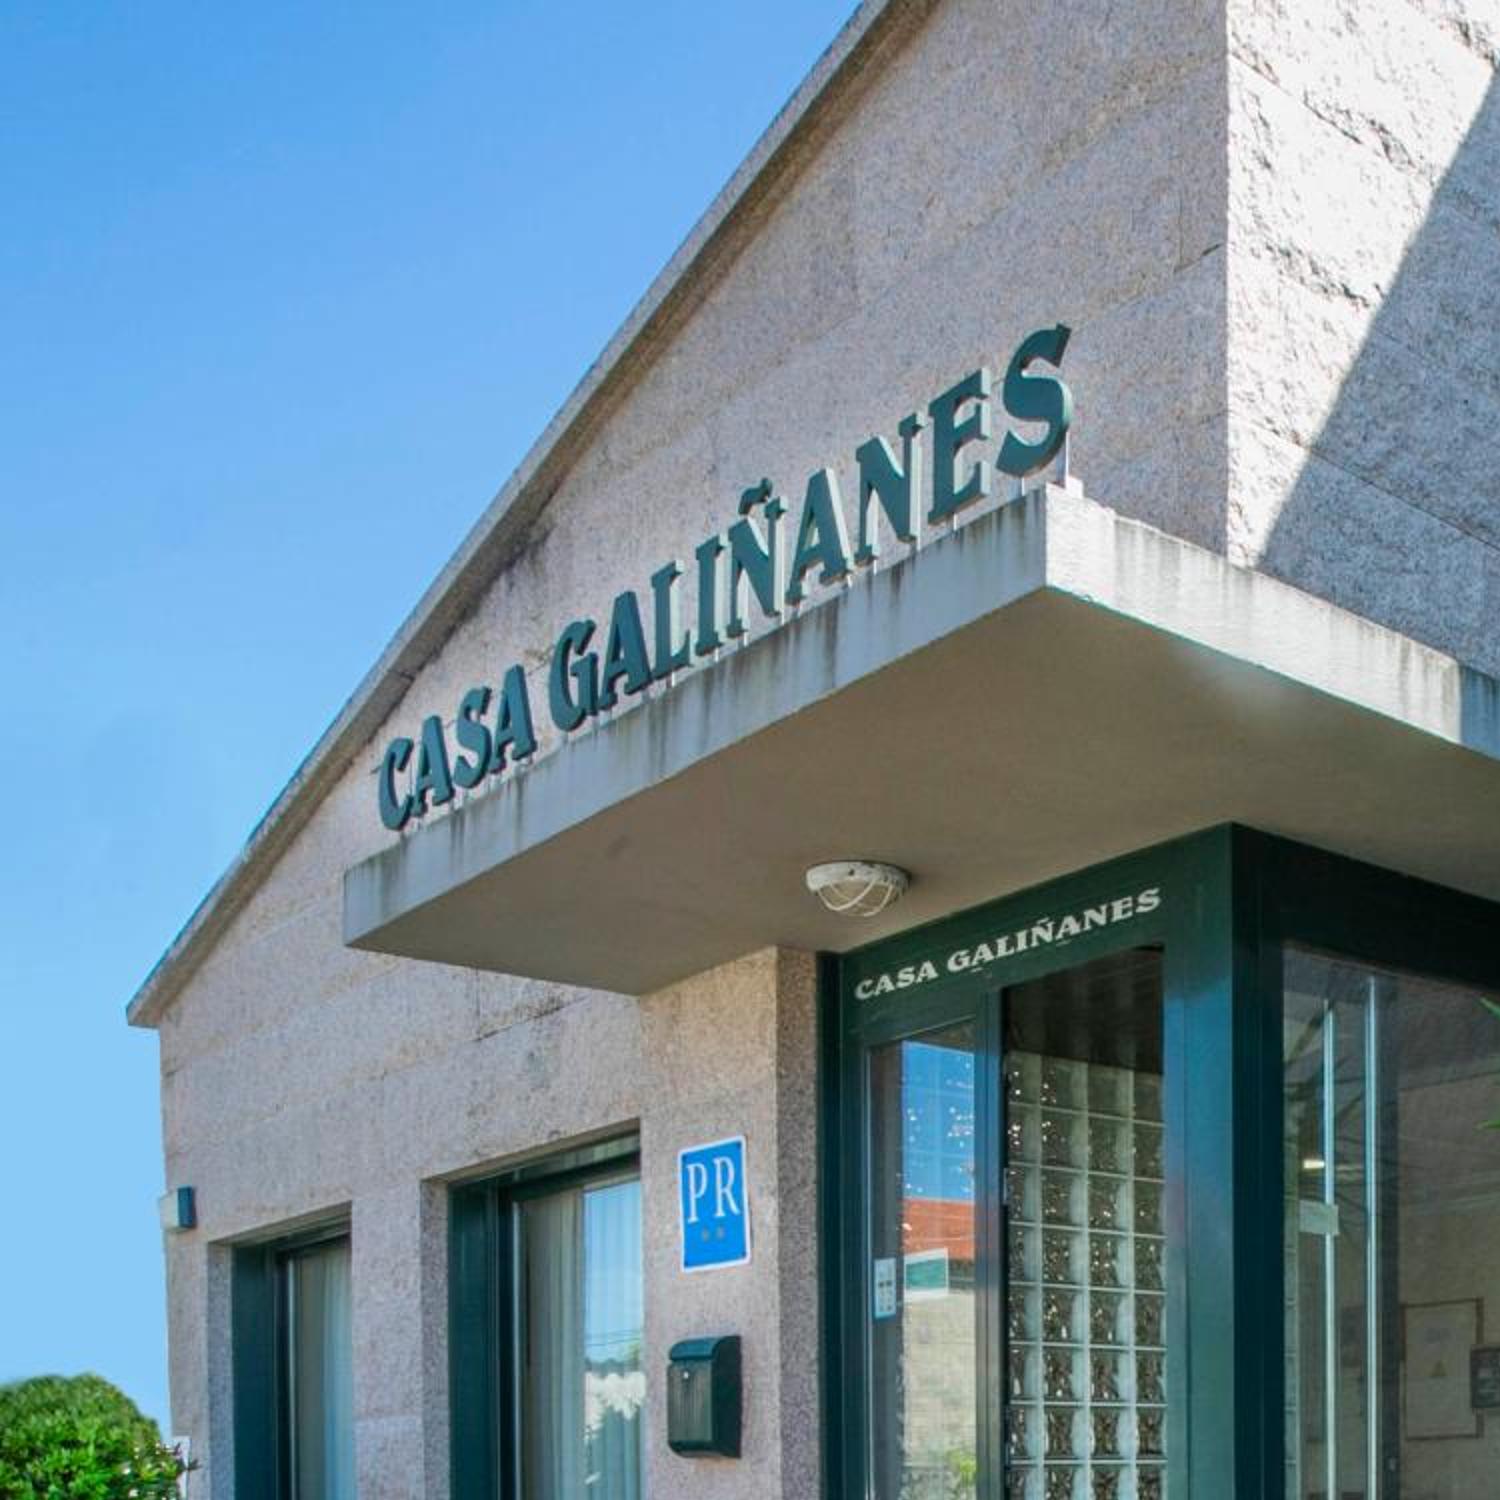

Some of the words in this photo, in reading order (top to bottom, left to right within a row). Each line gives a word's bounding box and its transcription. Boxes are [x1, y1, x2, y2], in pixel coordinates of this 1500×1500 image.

[377, 663, 539, 832] CASA
[548, 323, 1072, 733] GALIÑANES
[854, 960, 939, 1000] CASA
[946, 887, 1161, 973] GALIÑANES
[686, 1156, 742, 1223] PR
